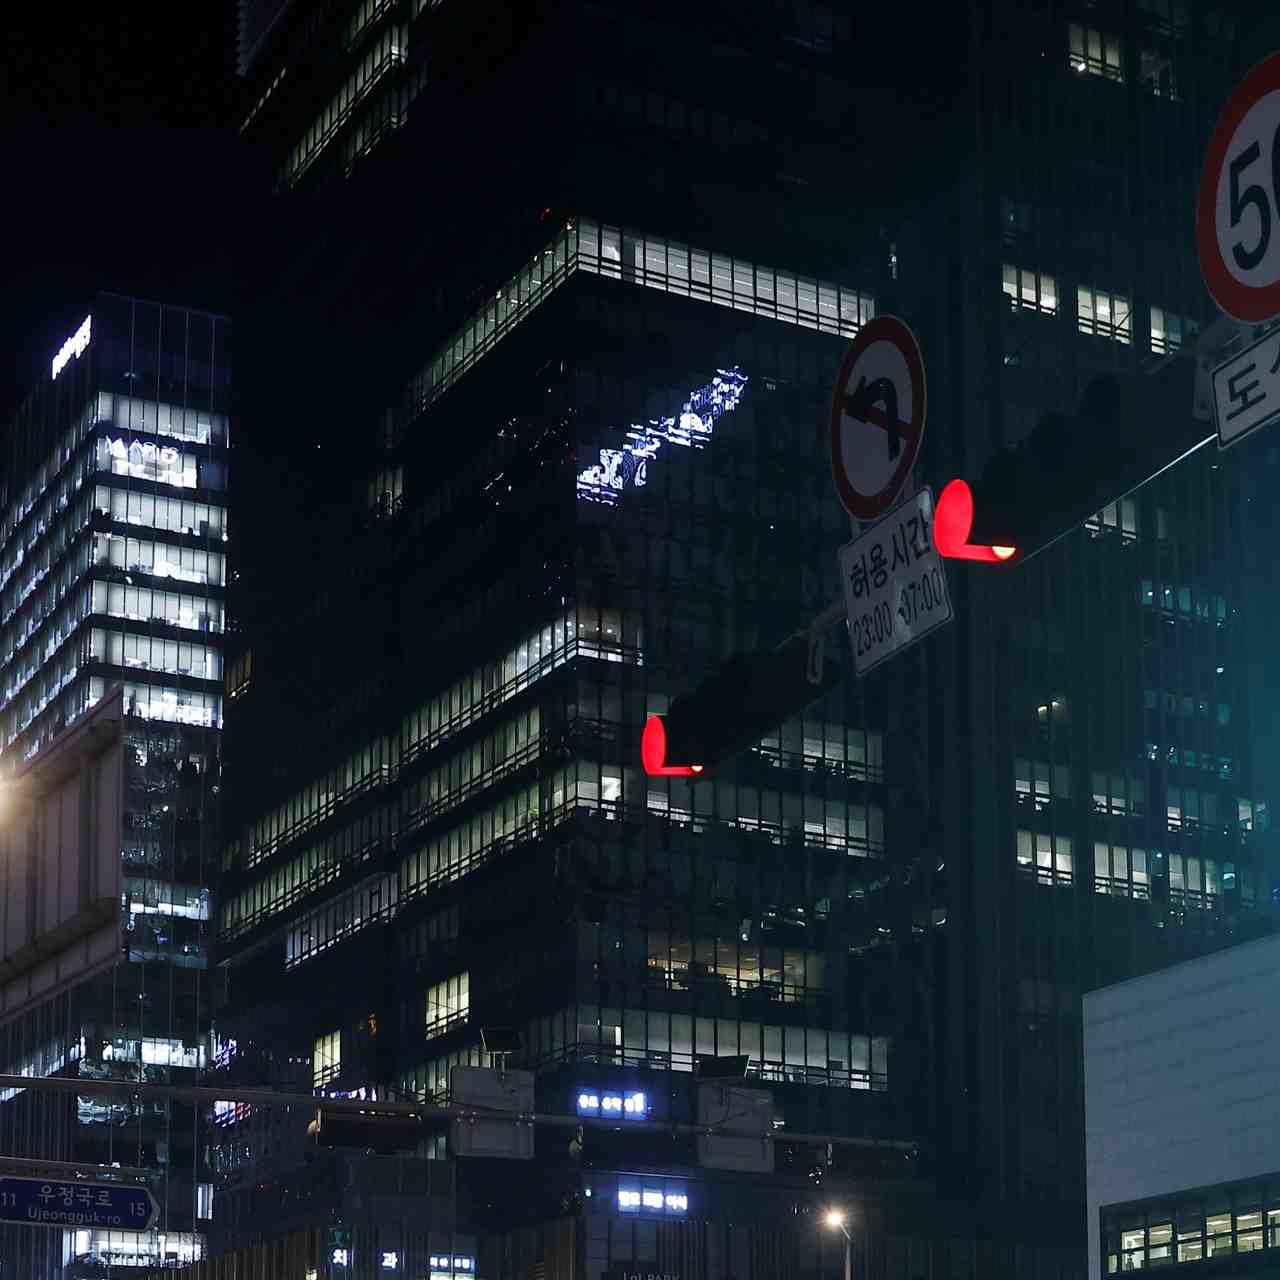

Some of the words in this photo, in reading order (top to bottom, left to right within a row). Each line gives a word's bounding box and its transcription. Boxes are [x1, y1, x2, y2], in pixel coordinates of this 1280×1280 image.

[850, 509, 930, 599] 허용시간
[1, 1192, 17, 1207] 11
[38, 1184, 113, 1208] 우정국로
[129, 1202, 146, 1217] 15
